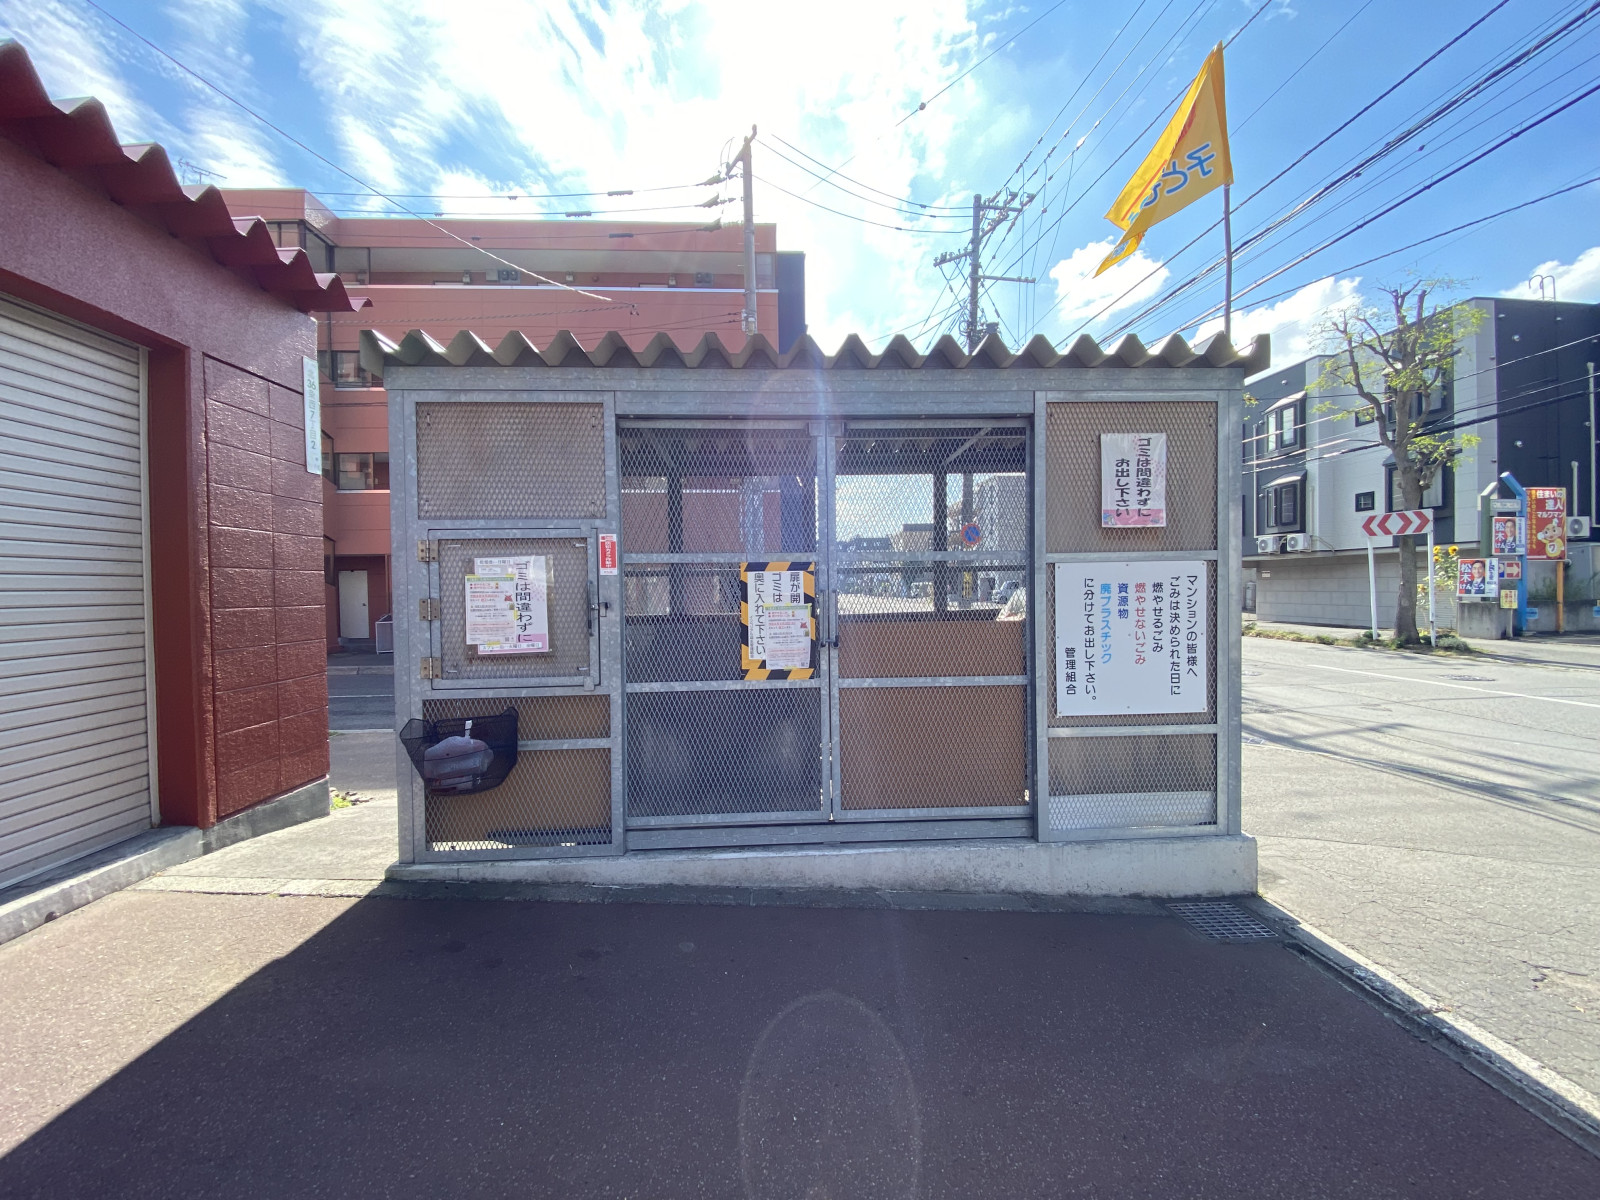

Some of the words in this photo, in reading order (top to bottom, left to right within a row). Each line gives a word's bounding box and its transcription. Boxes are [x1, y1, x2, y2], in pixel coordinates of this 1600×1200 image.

[1114, 458, 1131, 517] お出し下さい
[1136, 437, 1152, 517] ゴミは間違わずに
[1536, 489, 1564, 499] 住まいの
[1545, 499, 1564, 510] 達人
[515, 560, 533, 642] ゴミは間違わずに
[772, 573, 783, 602] ゴミは
[1117, 583, 1129, 619] 資源物
[1460, 563, 1472, 582] 松木
[754, 572, 766, 655] 奥に入れて下さい
[1083, 577, 1097, 701] に分けてお出し下さい。
[1100, 583, 1112, 664] 廃プラスチック
[1134, 582, 1146, 665] 燃やせないごみ
[1152, 582, 1164, 653] 燃やせるごみ
[1169, 576, 1181, 695] ごみは決められた日に
[1186, 575, 1198, 677] マンションの皆様へ
[1064, 647, 1077, 695] 管理組合
